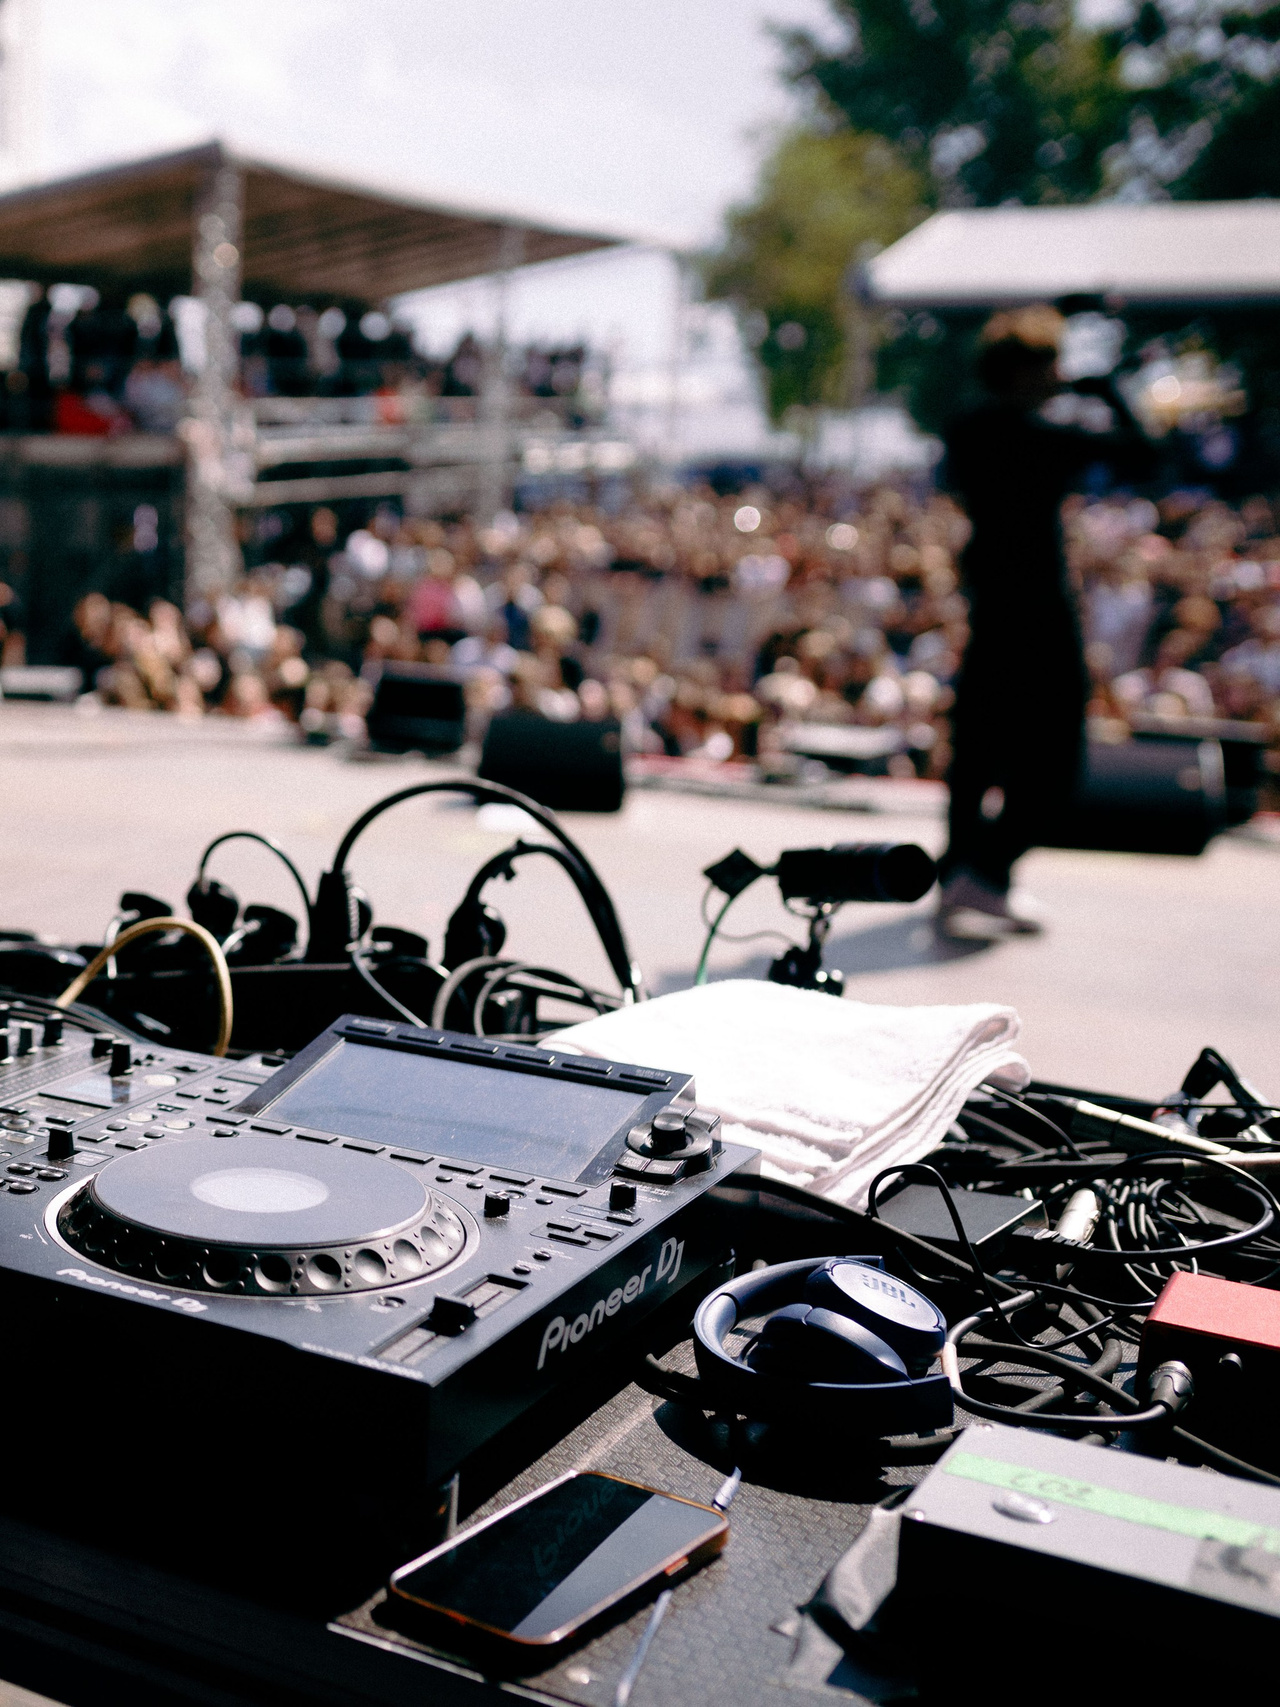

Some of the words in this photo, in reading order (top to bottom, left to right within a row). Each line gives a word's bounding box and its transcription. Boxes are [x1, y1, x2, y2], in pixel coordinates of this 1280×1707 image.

[537, 1263, 653, 1371] Pioneer
[655, 1236, 686, 1285] DJ
[861, 1273, 916, 1309] JBL
